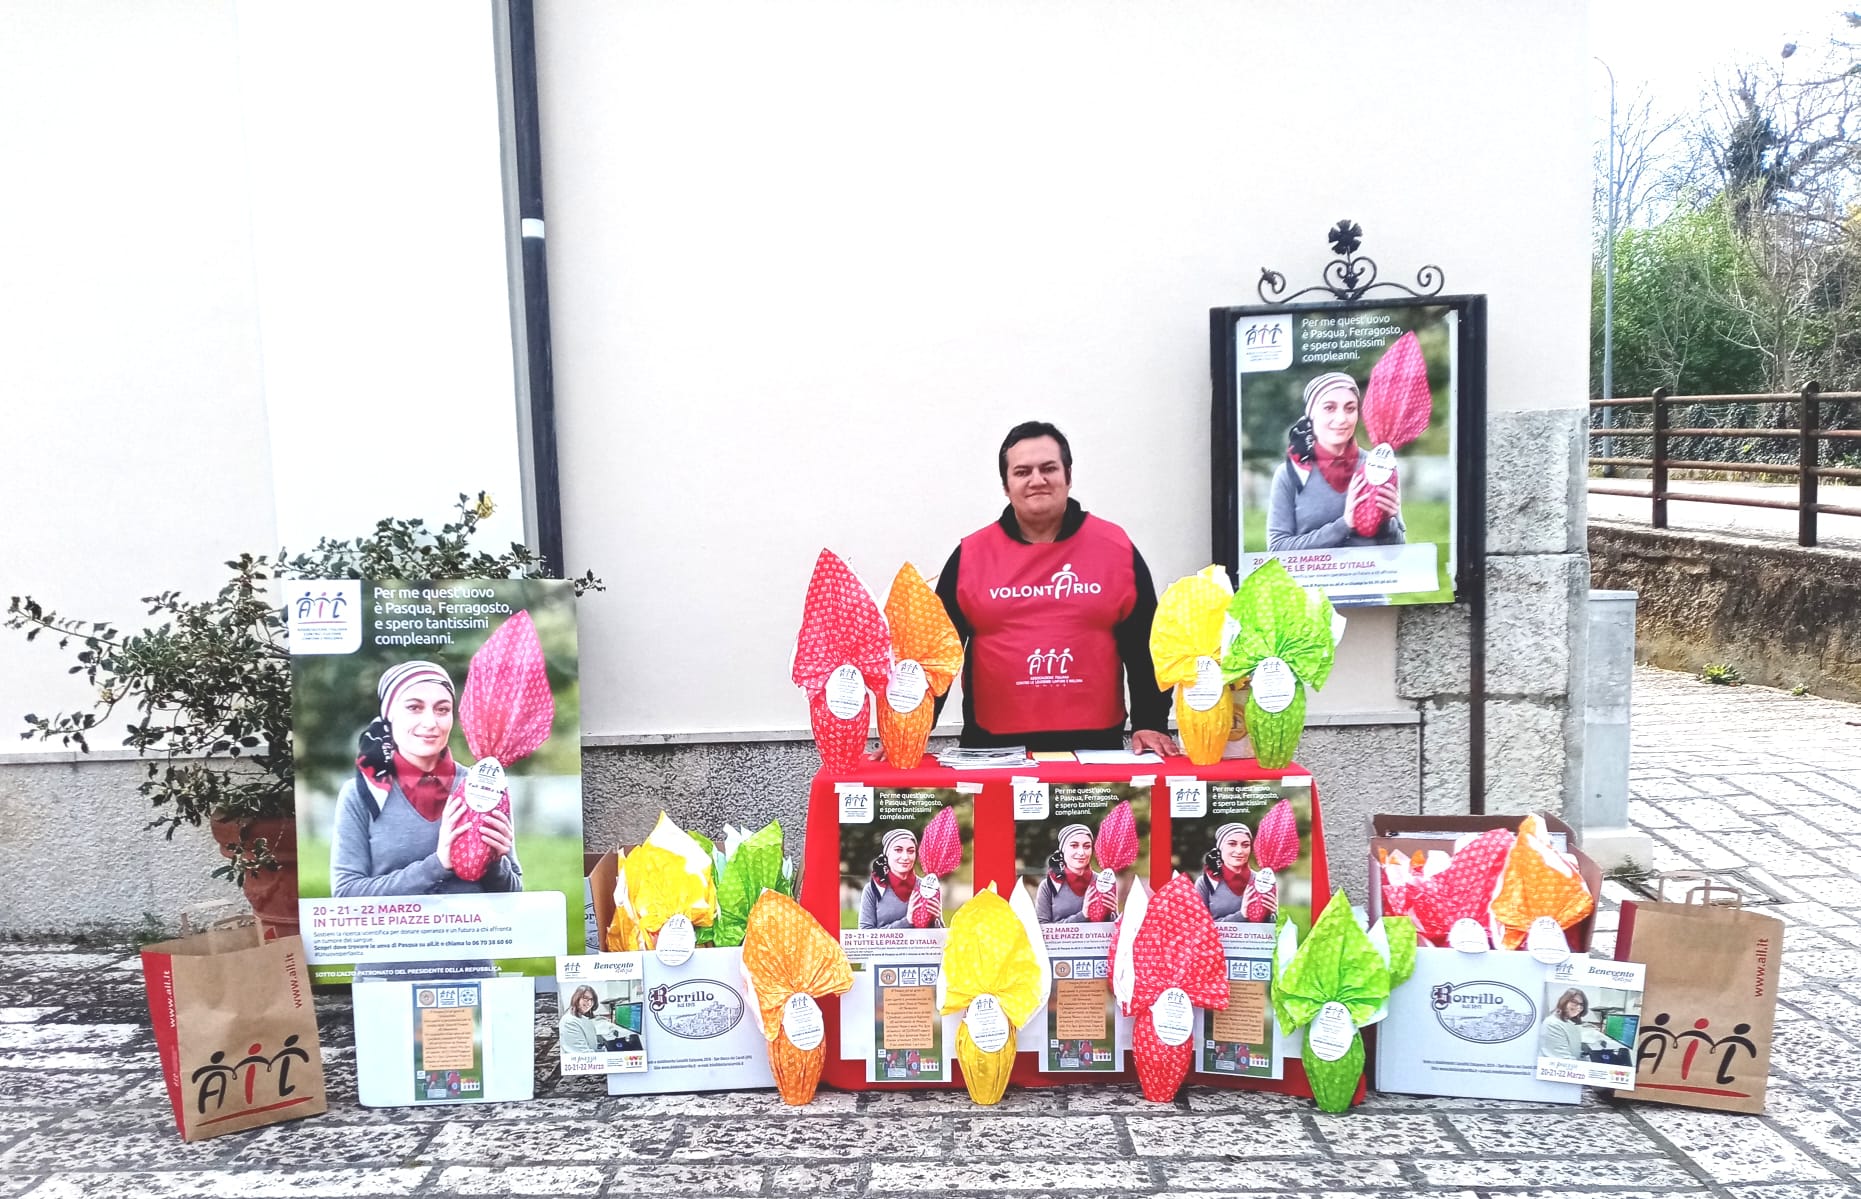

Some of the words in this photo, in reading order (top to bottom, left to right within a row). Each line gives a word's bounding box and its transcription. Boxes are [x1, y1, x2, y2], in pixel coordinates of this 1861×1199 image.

[1302, 318, 1319, 328] Per
[1320, 319, 1335, 327] me
[1302, 329, 1309, 339] è
[1311, 328, 1347, 340] Pasqua,
[1349, 325, 1403, 337] Ferragosto,
[1302, 343, 1309, 351] e
[1311, 341, 1338, 352] spero
[1340, 337, 1386, 348] tantissimi
[1302, 350, 1361, 362] compleanni.
[1253, 558, 1264, 566] 20
[1287, 556, 1298, 564] 22
[1300, 554, 1333, 563] MARZO
[1294, 563, 1305, 573] LE
[1307, 562, 1338, 572] PIAZZE
[1339, 560, 1377, 570] D'ITALIA
[989, 563, 1102, 600] VOLONTARIO
[374, 587, 396, 599] Per
[399, 588, 419, 599] me
[374, 602, 383, 614] è
[385, 602, 436, 617] Pasqua,
[438, 602, 513, 617] Ferragosto,
[374, 620, 383, 630] e
[386, 619, 425, 632] spero
[426, 617, 490, 630] tantissimi
[375, 632, 455, 647] compleanni.
[1055, 787, 1067, 795] Per
[908, 799, 943, 807] Ferragosto,
[1084, 794, 1120, 802] Ferragosto,
[1236, 799, 1268, 807] tantissimi
[1060, 802, 1078, 810] spero
[1078, 801, 1108, 809] tantissimi
[1212, 807, 1251, 815] compleanni.
[1055, 809, 1092, 817] compleanni.
[313, 906, 327, 916] 20
[337, 905, 350, 915] 21
[361, 904, 375, 914] 22
[378, 903, 422, 914] MARZO
[313, 918, 327, 928] IN
[329, 917, 368, 928] TUTTE
[371, 916, 385, 927] LE
[388, 915, 430, 926] PIAZZE
[433, 913, 482, 925] D'ITALIA
[407, 967, 444, 975] PRESIDENTE
[464, 965, 503, 973] REPUBBLICA
[593, 961, 634, 971] Benevento
[1587, 965, 1636, 978] Benevento
[1754, 938, 1769, 998] www.ail.it
[285, 952, 303, 1009] www.ail.it
[163, 970, 178, 1028] www.ail.it
[588, 1062, 605, 1070] Marzo
[192, 1034, 310, 1114] AIL
[1566, 1070, 1586, 1080] Marzo
